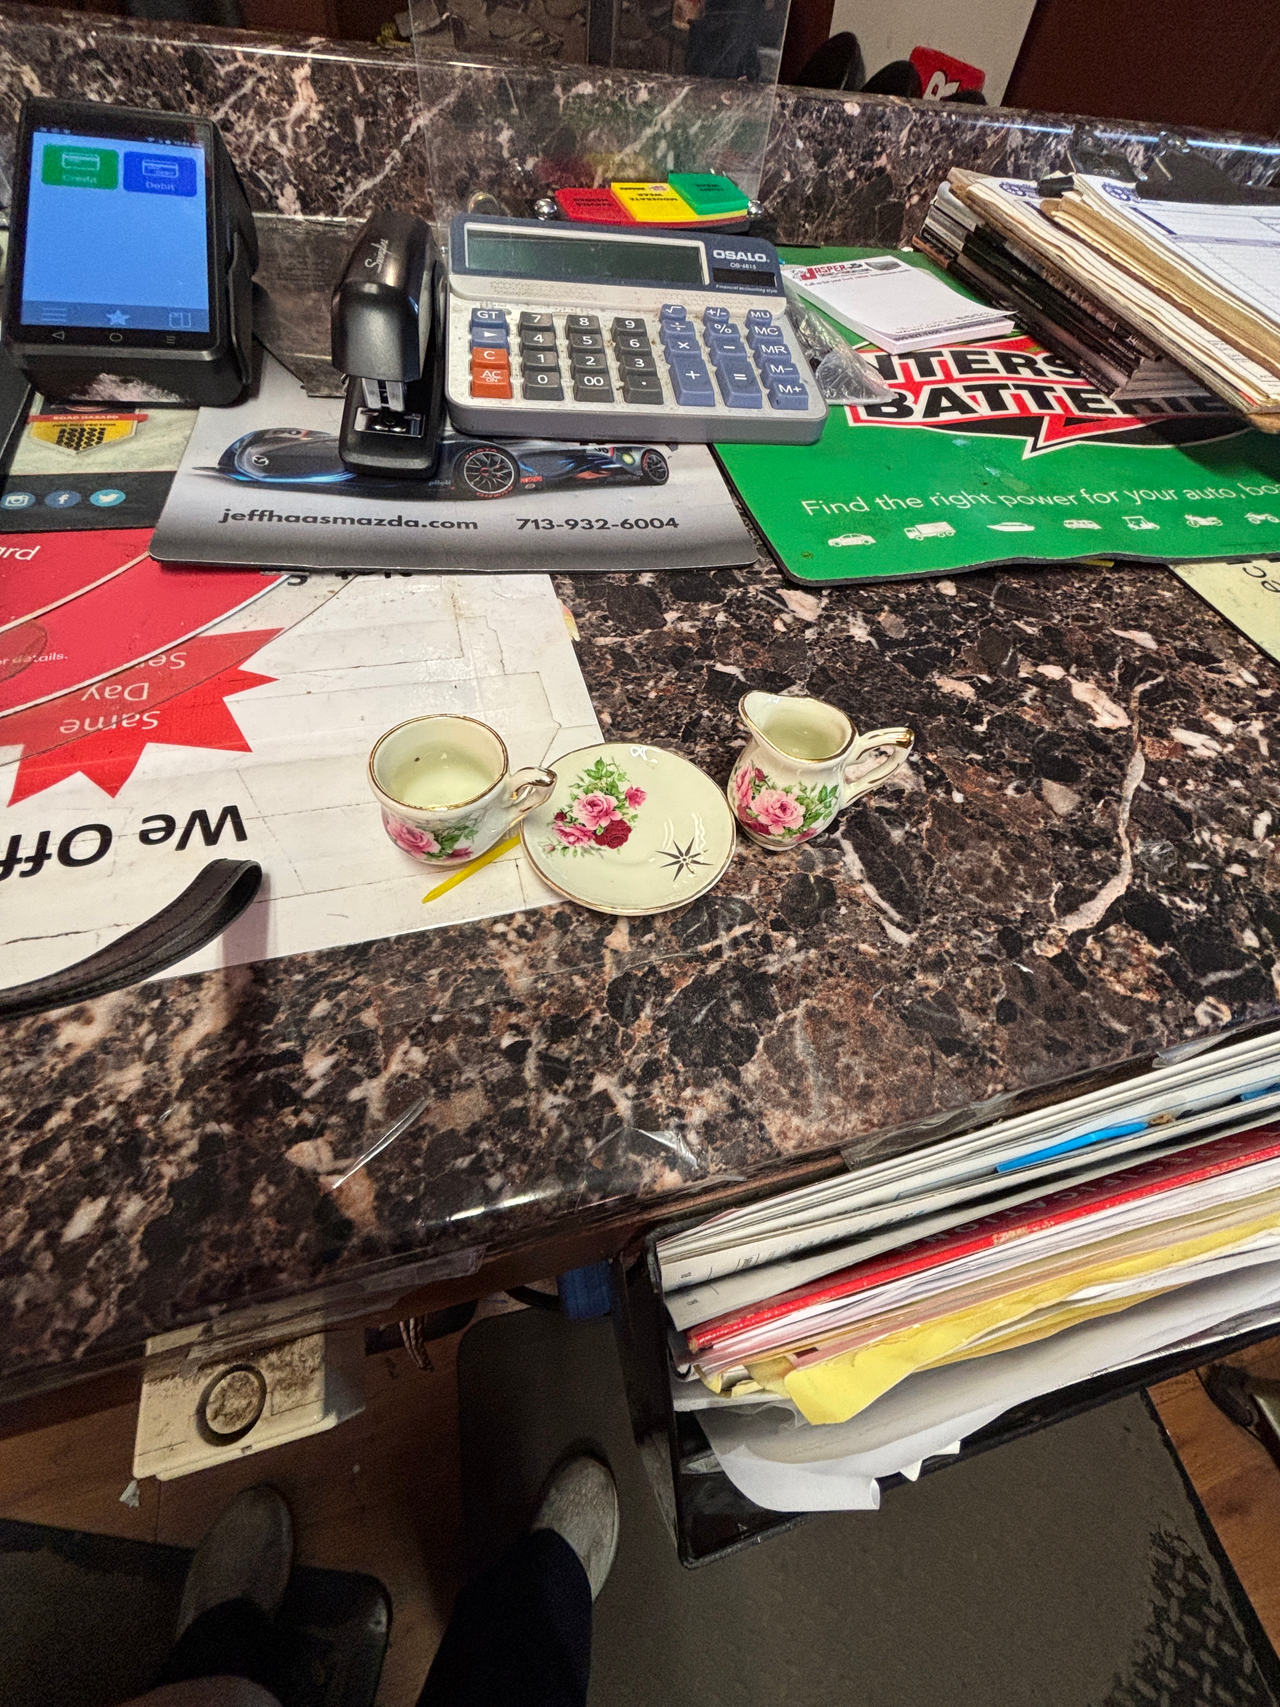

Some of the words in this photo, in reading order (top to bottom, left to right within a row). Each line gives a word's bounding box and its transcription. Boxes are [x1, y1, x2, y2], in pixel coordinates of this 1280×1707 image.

[145, 180, 176, 192] Debit
[712, 249, 767, 263] OSALO
[476, 310, 499, 320] GT
[530, 314, 542, 323] 7
[750, 310, 770, 319] MU
[579, 317, 590, 327] 8
[624, 319, 636, 329] 9
[754, 325, 779, 336] MC
[533, 334, 545, 344] 4
[582, 335, 593, 345] 5
[629, 338, 640, 348] 6
[760, 344, 788, 354] MR
[483, 350, 496, 360] C
[537, 354, 545, 363] 1
[585, 356, 596, 366] 2
[634, 358, 645, 368] 3
[481, 370, 500, 379] AC
[537, 374, 548, 384] 0
[584, 376, 604, 386] 00
[778, 383, 802, 394] M+
[801, 496, 870, 516] Find
[874, 493, 924, 511] the
[929, 491, 998, 509] right
[998, 493, 1079, 508] power
[1080, 488, 1120, 505] for
[1123, 488, 1179, 505] your
[1182, 486, 1246, 500] auto,
[1236, 482, 1280, 496] bo
[217, 508, 479, 531] jeffhaasmazda.com
[516, 516, 680, 531] 713-932-6004
[80, 682, 150, 702] Day
[60, 710, 161, 735] Same
[138, 805, 248, 852] We
